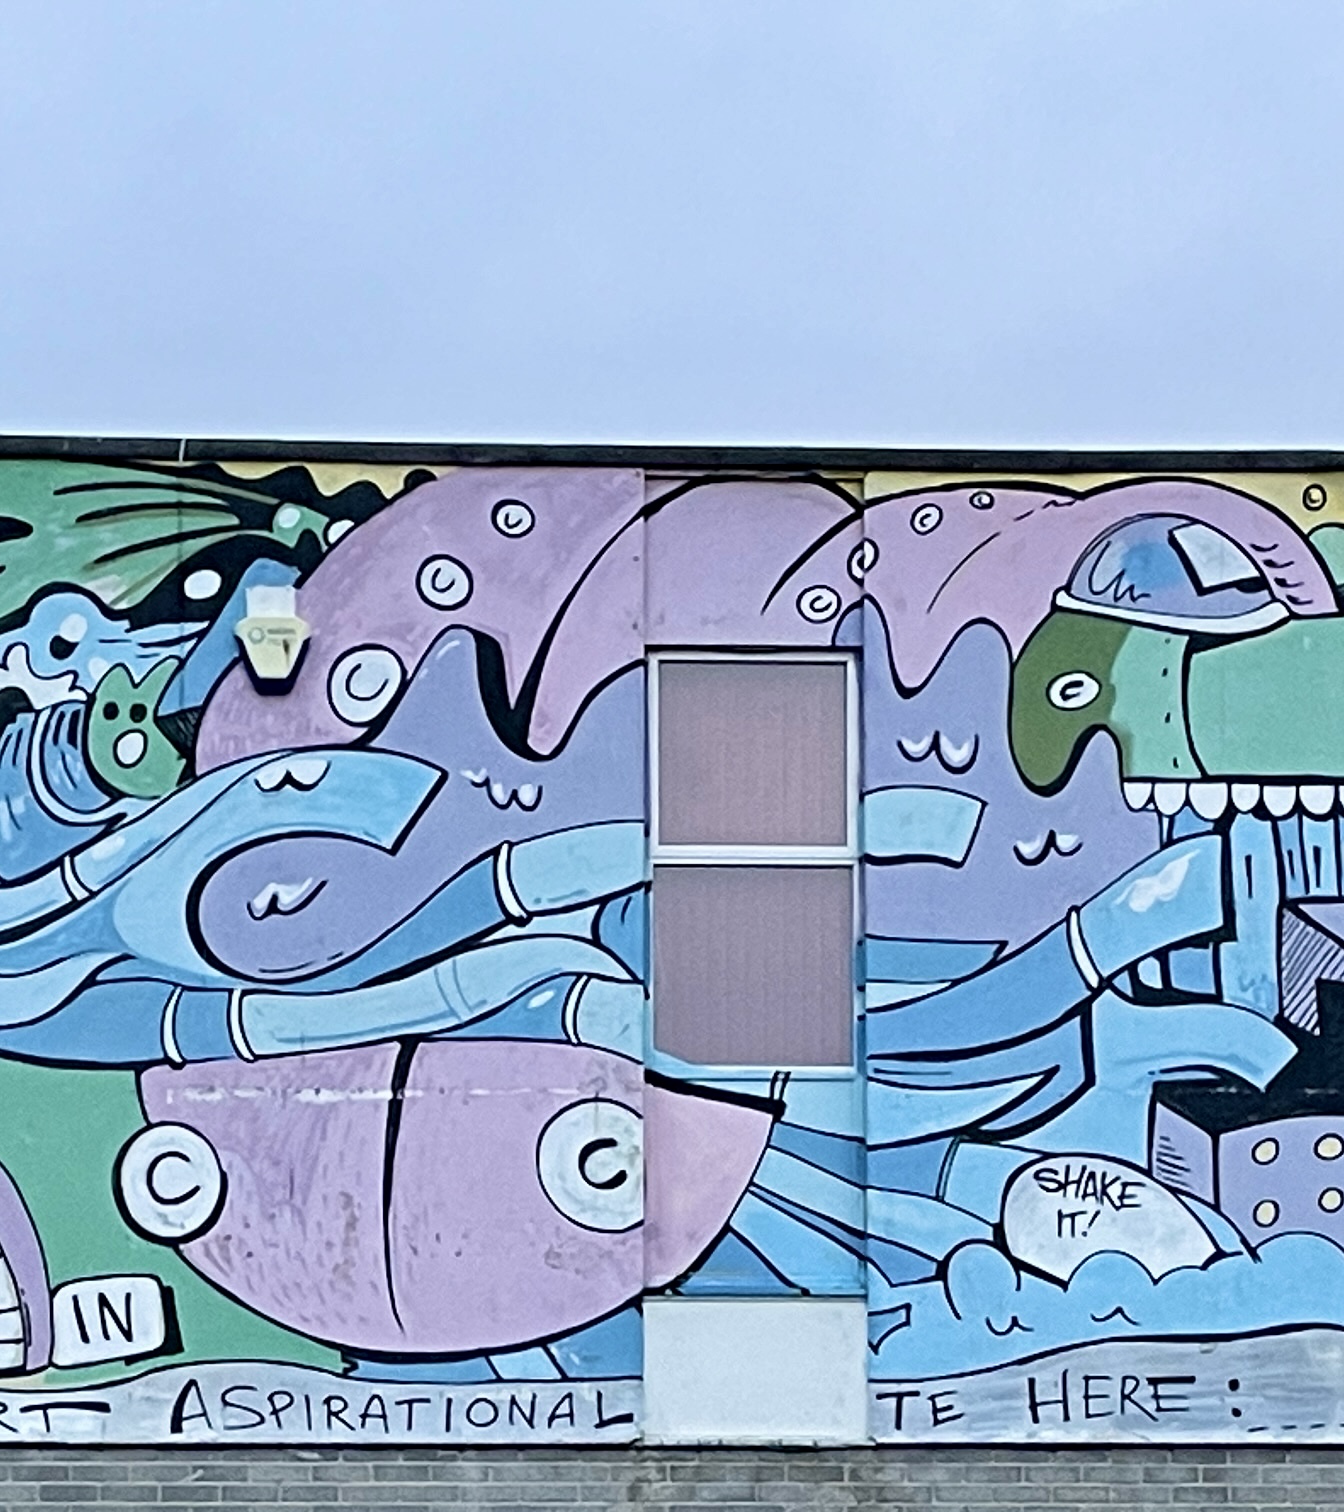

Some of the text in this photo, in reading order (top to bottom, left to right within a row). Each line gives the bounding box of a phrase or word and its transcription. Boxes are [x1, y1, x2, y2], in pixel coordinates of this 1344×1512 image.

[1033, 1164, 1146, 1211] SHAKE
[1057, 1209, 1101, 1238] IT!
[72, 1292, 133, 1343] IN
[170, 1378, 634, 1434] ASPIRATIONAL
